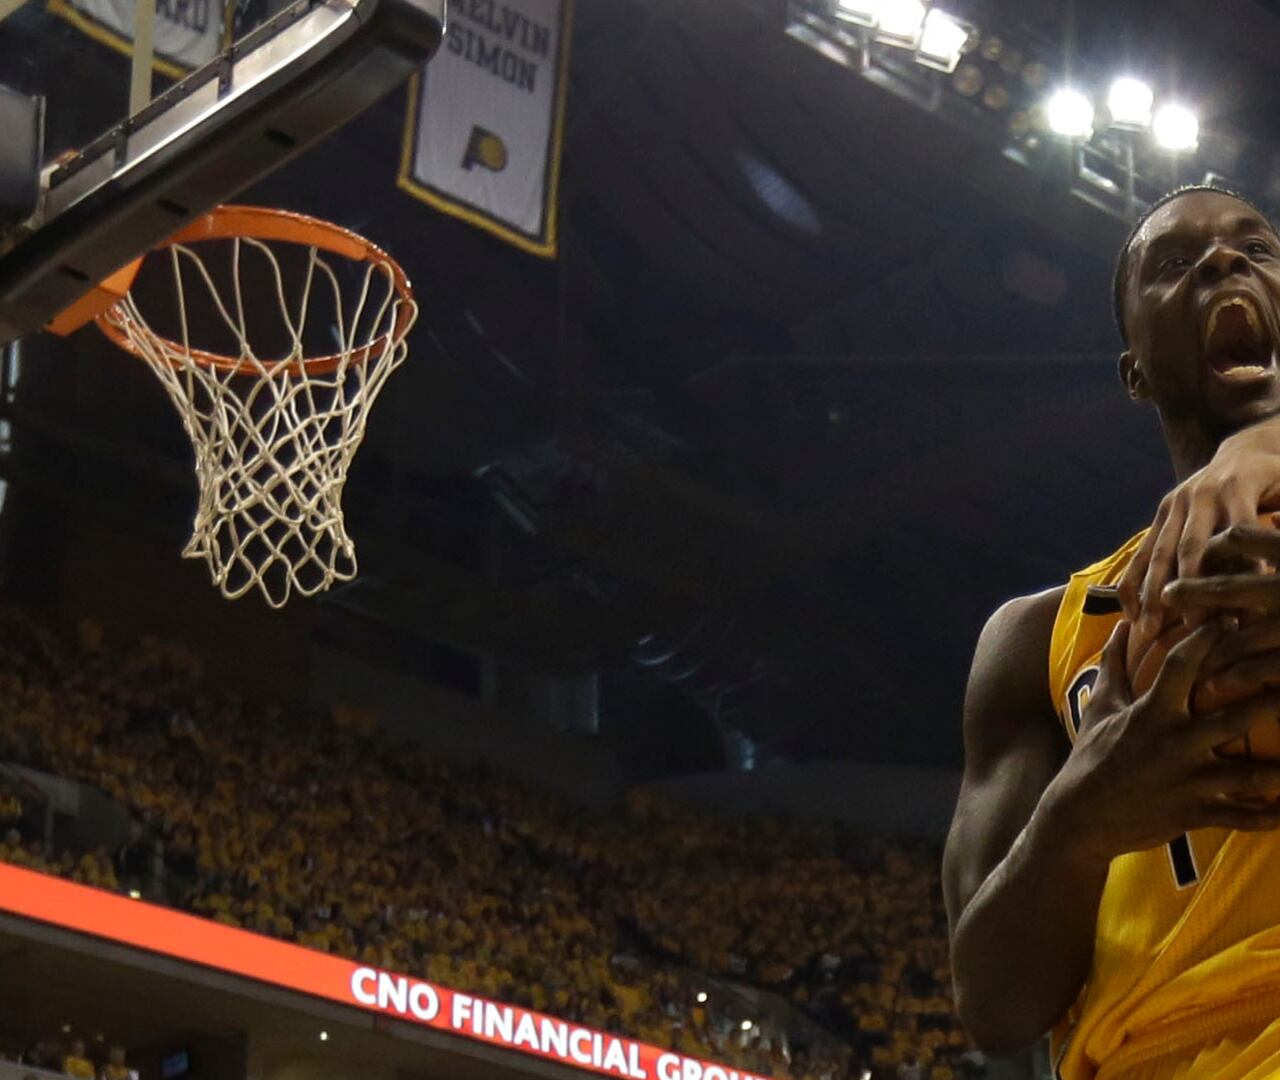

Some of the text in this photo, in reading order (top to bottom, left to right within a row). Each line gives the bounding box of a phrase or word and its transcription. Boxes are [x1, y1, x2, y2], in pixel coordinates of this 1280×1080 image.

[447, 21, 538, 94] SIMON
[350, 966, 439, 1020] CNO
[452, 993, 647, 1079] FINANCIAL
